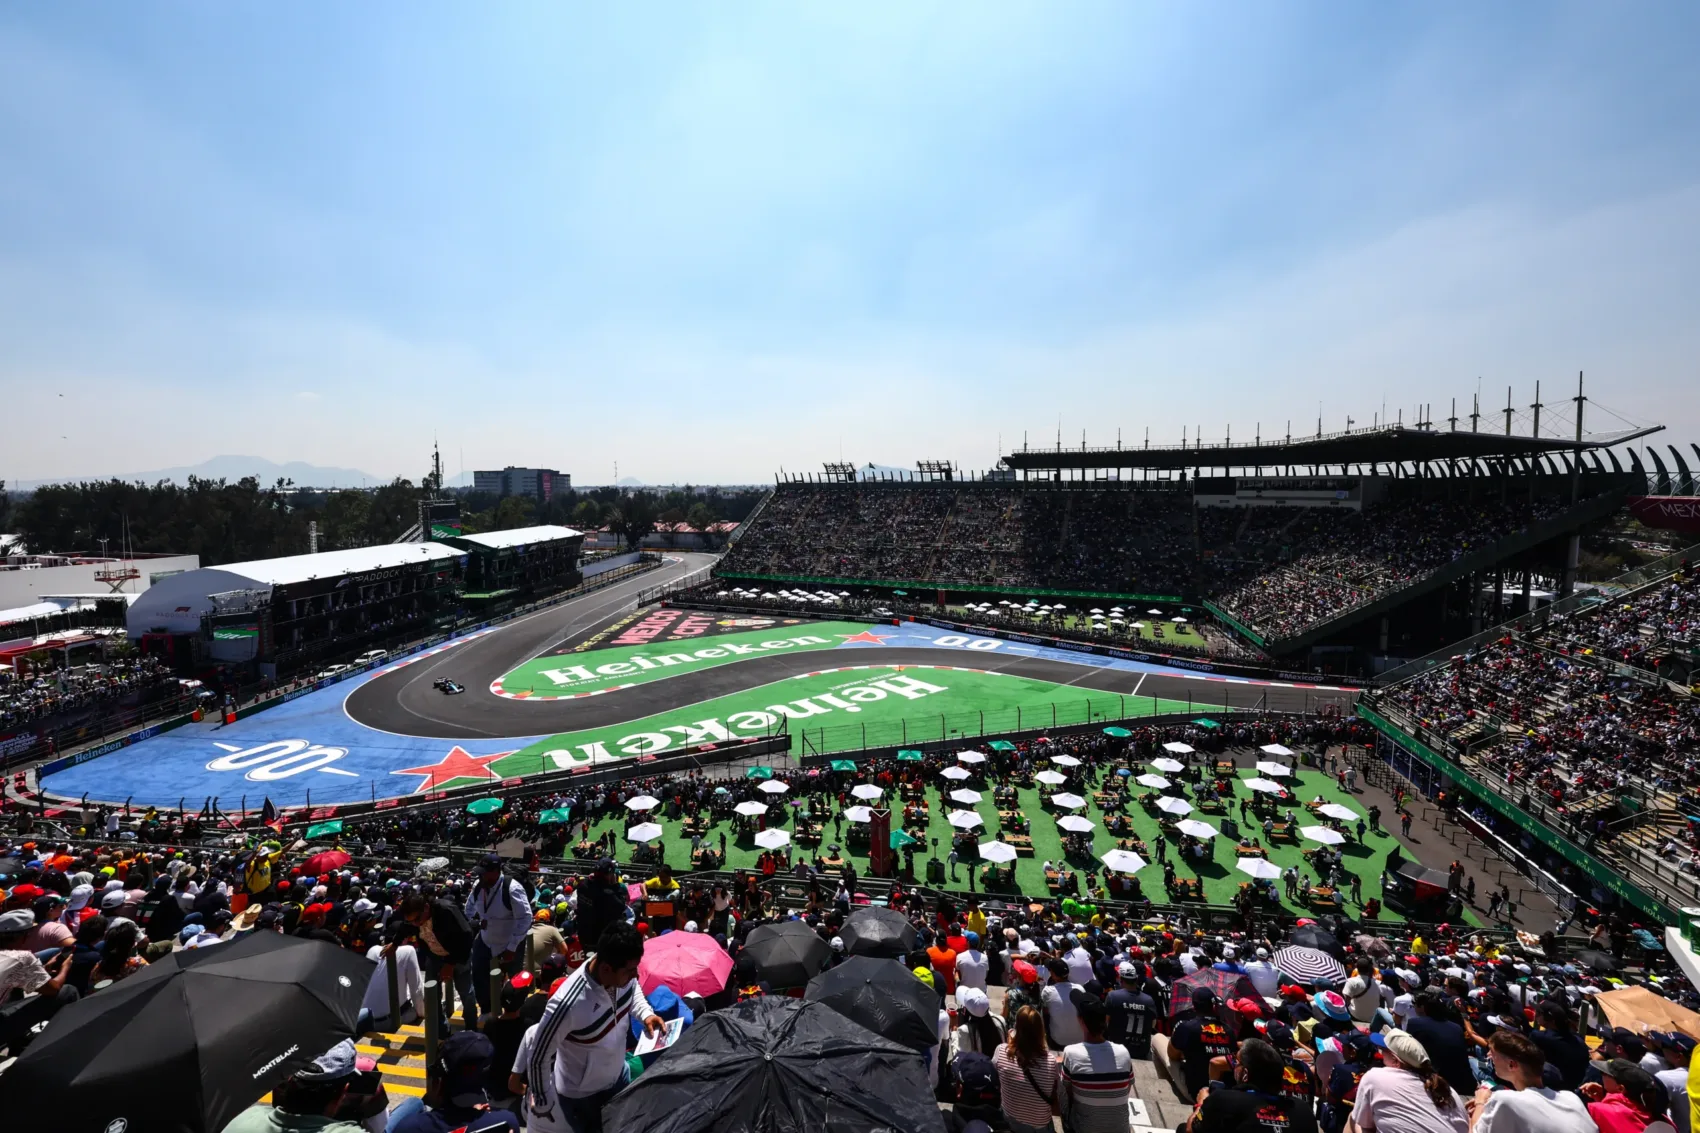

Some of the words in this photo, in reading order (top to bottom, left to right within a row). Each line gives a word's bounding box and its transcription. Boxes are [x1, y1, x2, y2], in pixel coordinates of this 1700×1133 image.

[1660, 503, 1700, 518] MEX
[610, 610, 684, 645] MEXICO
[672, 615, 716, 636] CITY
[1055, 641, 1093, 652] #MexicoGP
[537, 635, 833, 685] Heineken
[1108, 649, 1150, 661] #MexicoGP
[1167, 658, 1214, 671] #MexicoGP
[1278, 672, 1325, 683] #MexicoGP
[283, 687, 313, 702] Heineken
[542, 675, 949, 770] Heineken
[74, 741, 122, 764] Heineken
[1500, 807, 1515, 820] ROLEX
[1522, 822, 1539, 837] ROLEX
[1548, 840, 1566, 856] ROLEX
[1576, 859, 1596, 876] ROLEX
[1607, 881, 1629, 900] ROLEX
[1643, 905, 1666, 923] ROLEX
[1129, 1001, 1146, 1011] PÉREZ
[1126, 1013, 1145, 1034] 11
[1205, 1046, 1226, 1054] Mobil
[252, 1044, 299, 1079] MONTBLANC
